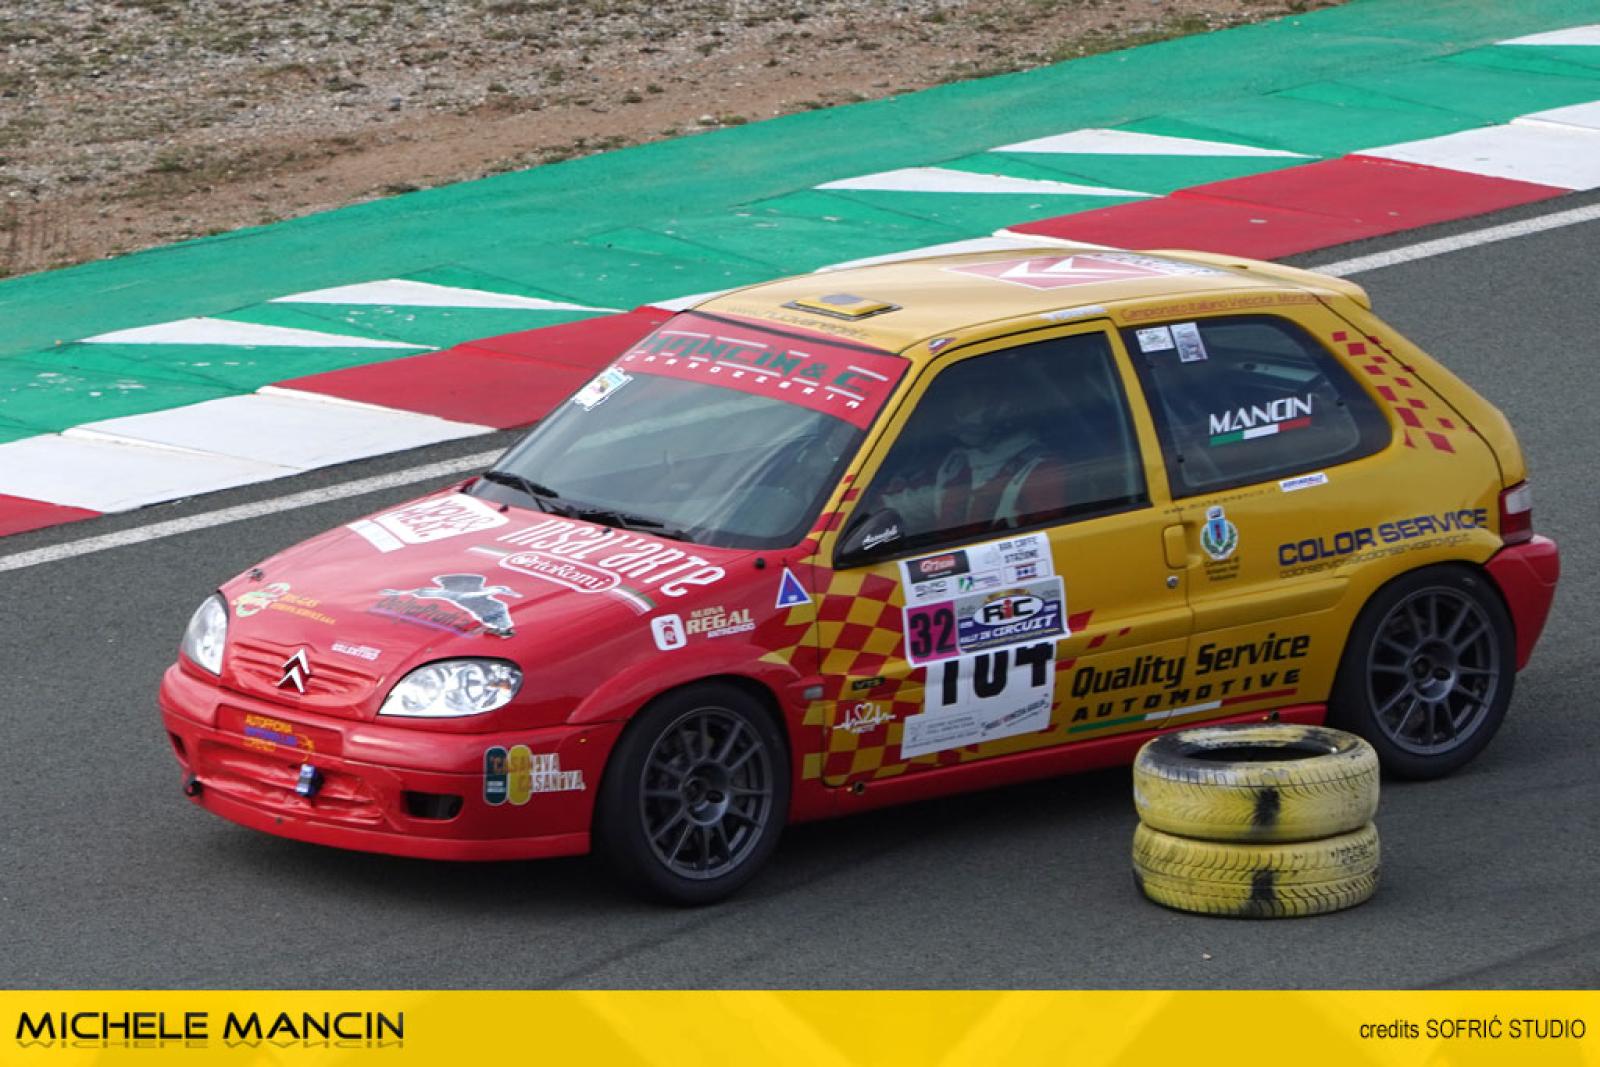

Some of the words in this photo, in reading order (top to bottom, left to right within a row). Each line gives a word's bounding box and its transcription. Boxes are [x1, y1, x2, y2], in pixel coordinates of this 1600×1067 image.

[1208, 393, 1312, 436] MANCIN
[1278, 527, 1378, 567] COLOR
[1378, 508, 1489, 543] SERVICE
[685, 608, 755, 635] REGAL
[909, 608, 956, 658] 32
[1070, 654, 1187, 699] Quality
[1194, 632, 1311, 676] Service
[1070, 667, 1302, 723] AUTOMOTIVE
